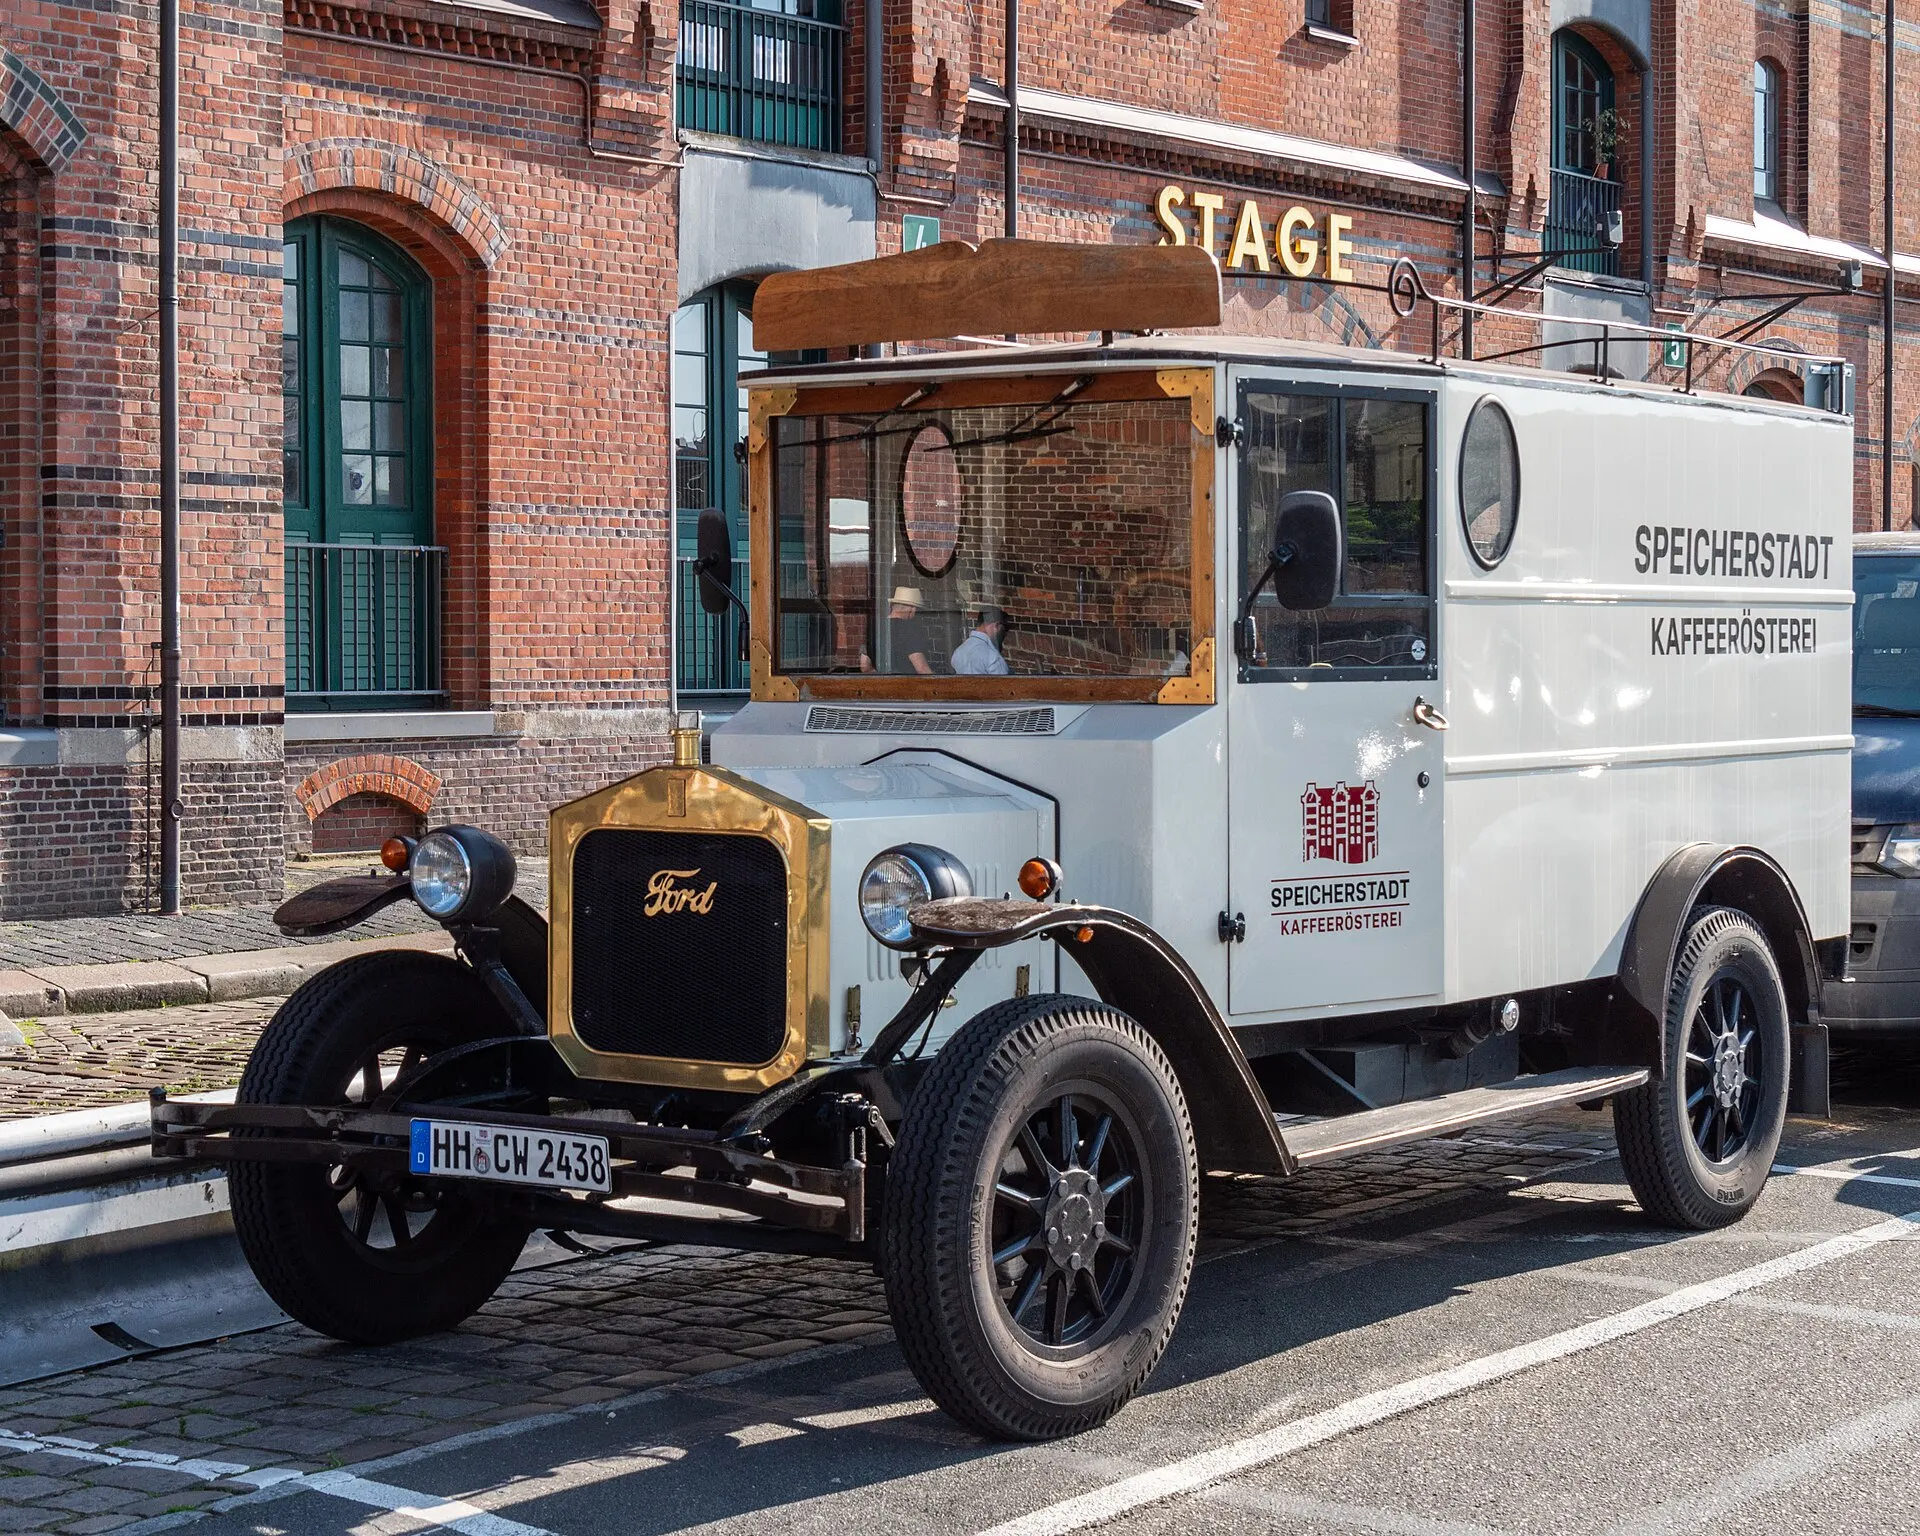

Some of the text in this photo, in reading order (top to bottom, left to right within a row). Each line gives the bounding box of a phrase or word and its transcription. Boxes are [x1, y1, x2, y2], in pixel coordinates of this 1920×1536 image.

[1155, 185, 1353, 282] STAGE
[1671, 329, 1680, 361] 5
[1634, 524, 1833, 580] SPEICHERSTADT
[1651, 608, 1817, 655] KAFFEERÖSTEREI
[644, 868, 718, 917] Ford
[1271, 879, 1410, 908] SPEICHERSTADT
[1280, 911, 1402, 936] KAFFEERÖSTEREI
[417, 1152, 425, 1164] D
[433, 1128, 606, 1185] HH CW 2438
